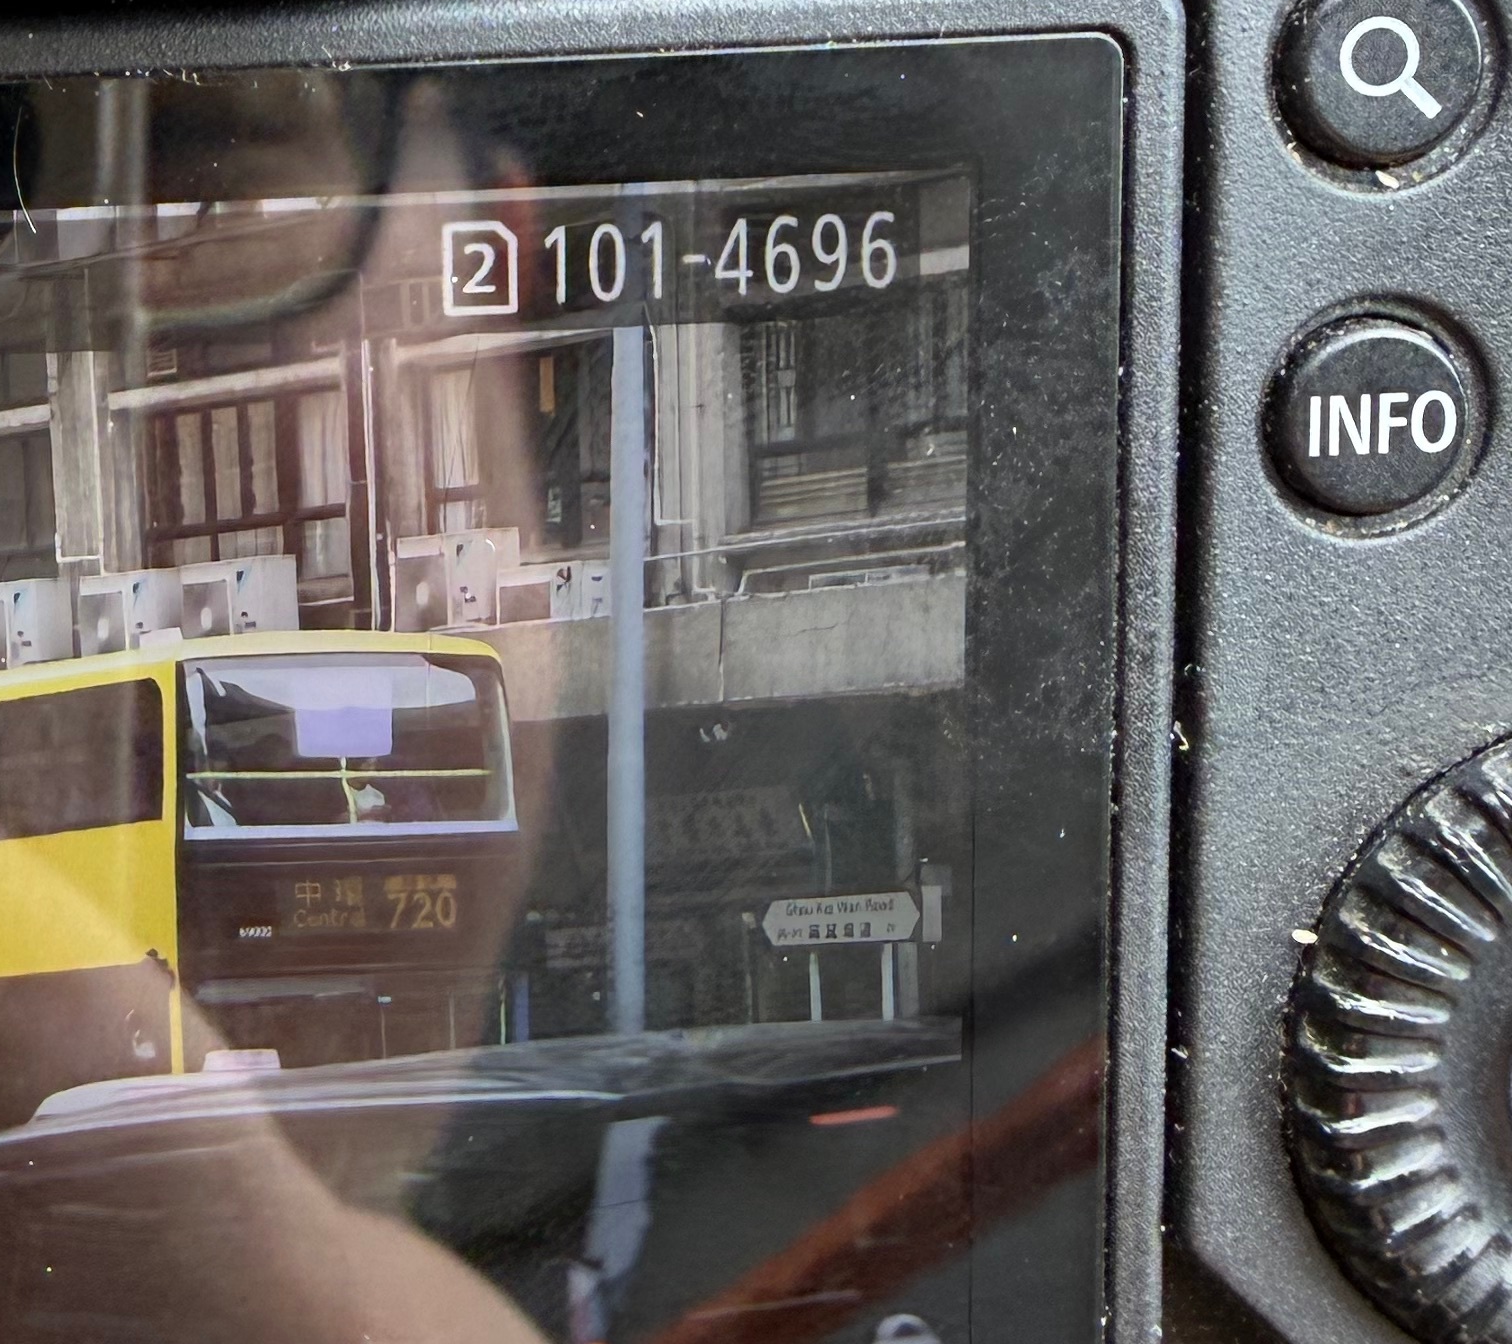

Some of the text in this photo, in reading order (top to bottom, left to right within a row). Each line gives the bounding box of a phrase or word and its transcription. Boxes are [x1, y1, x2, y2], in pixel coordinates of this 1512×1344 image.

[543, 211, 898, 305] 101-4696
[1308, 389, 1458, 458] INFO
[386, 891, 457, 929] 720
